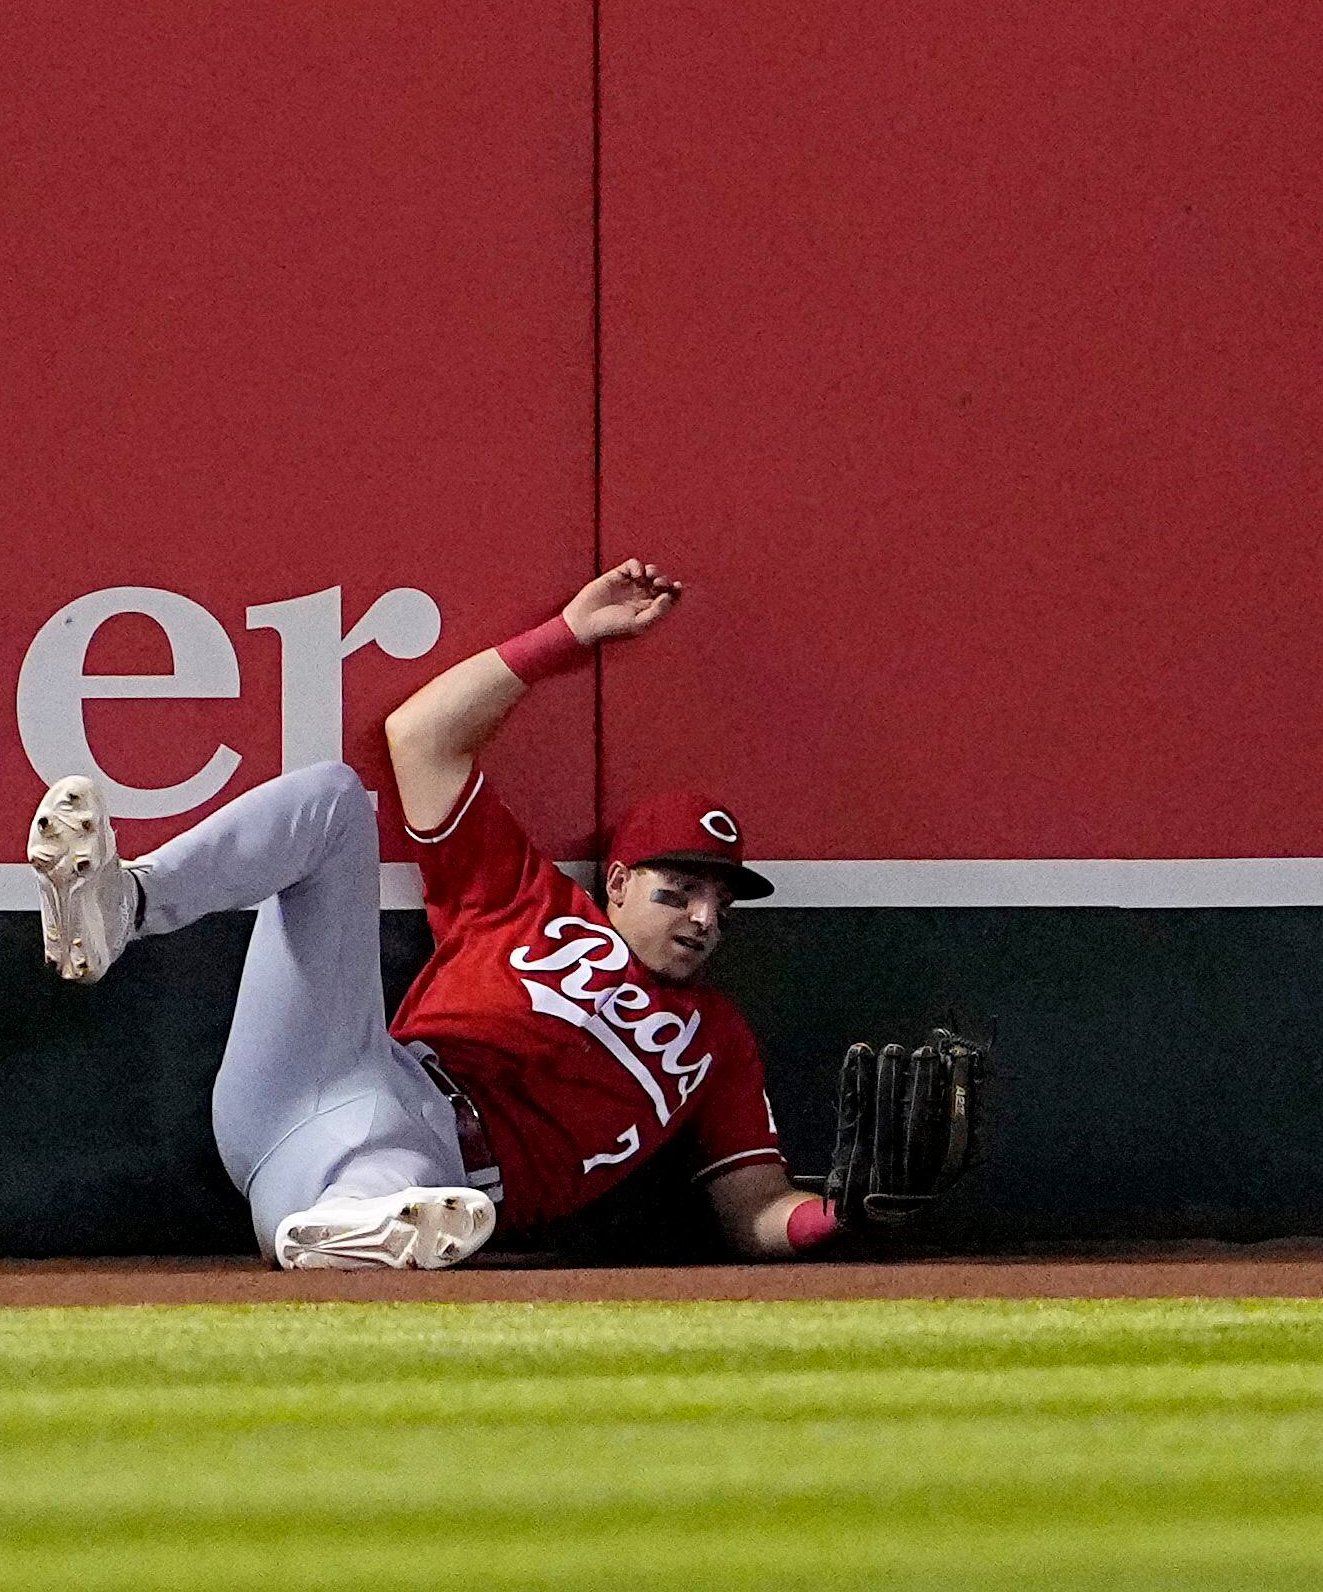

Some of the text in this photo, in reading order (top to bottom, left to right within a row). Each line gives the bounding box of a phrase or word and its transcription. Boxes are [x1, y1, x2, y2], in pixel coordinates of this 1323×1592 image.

[699, 810, 738, 843] C
[509, 915, 714, 1128] Reds
[582, 1123, 641, 1175] 7
